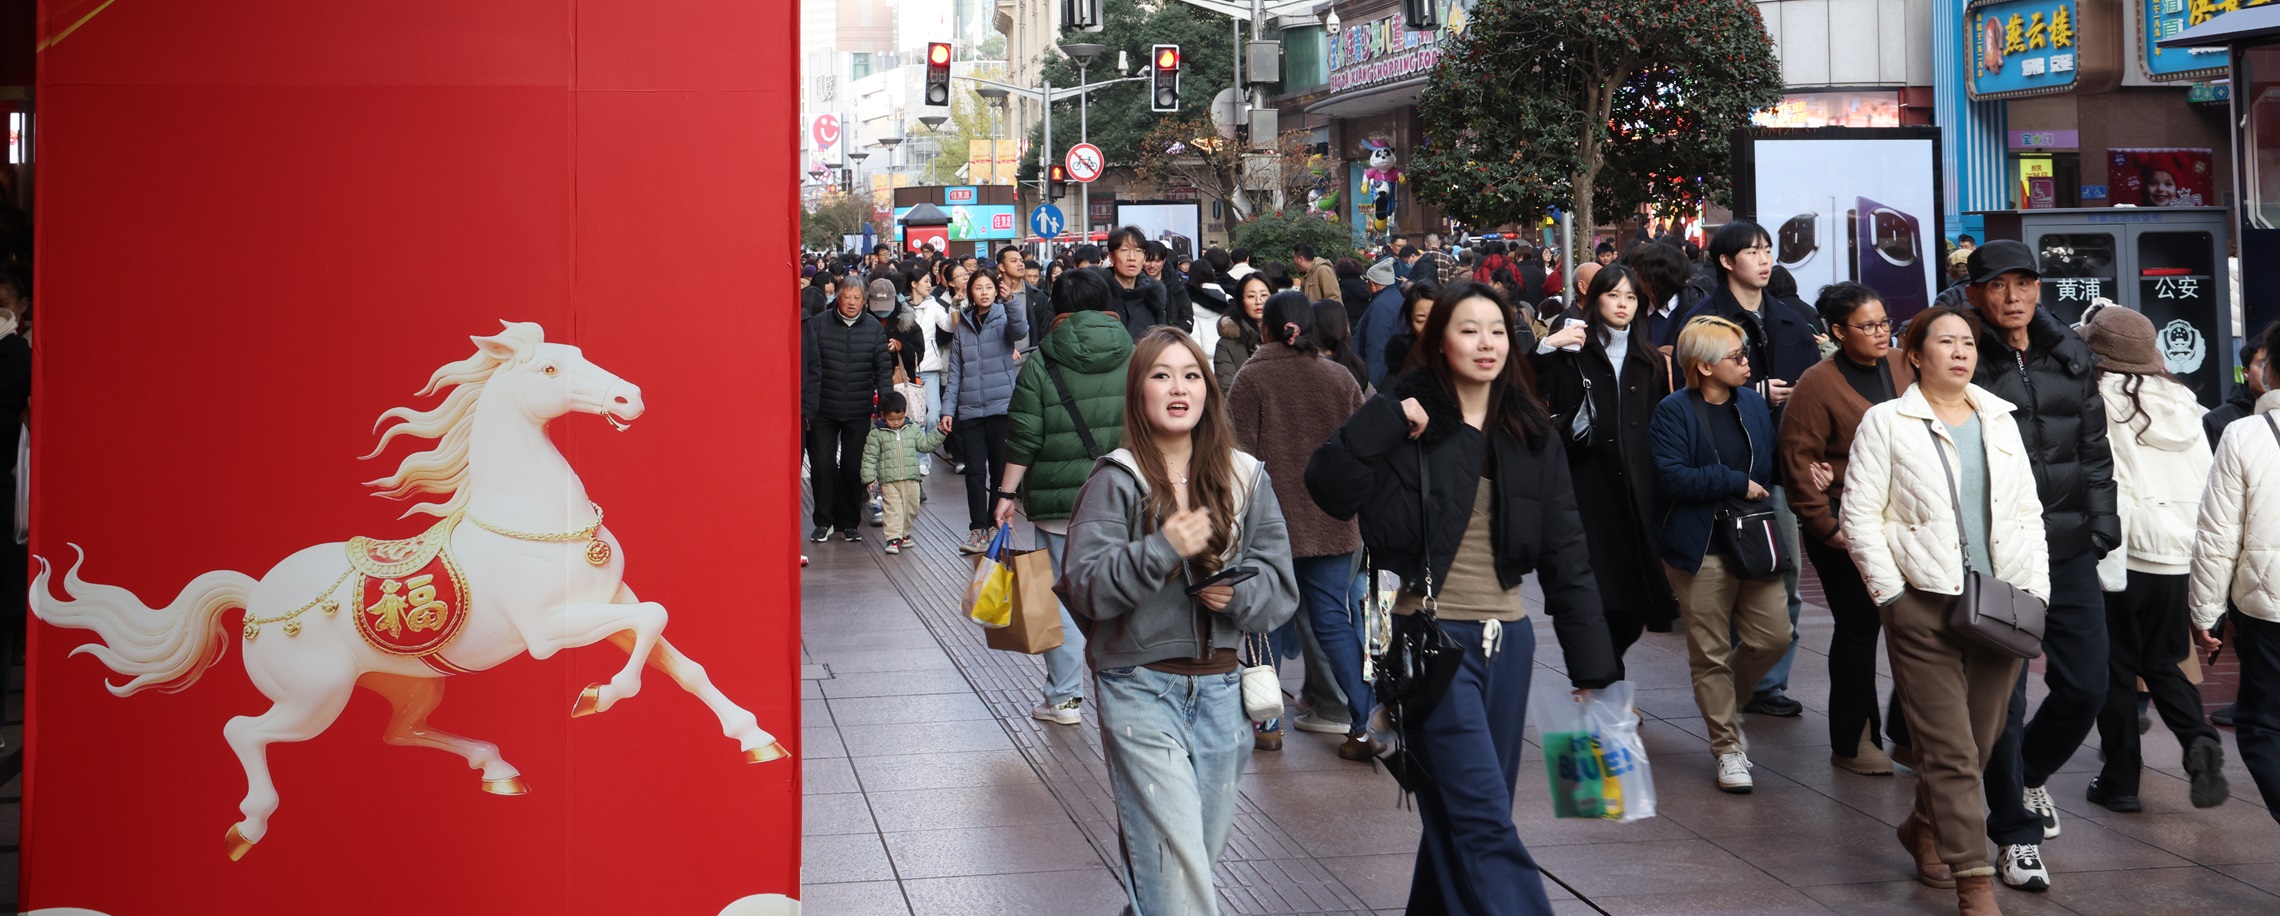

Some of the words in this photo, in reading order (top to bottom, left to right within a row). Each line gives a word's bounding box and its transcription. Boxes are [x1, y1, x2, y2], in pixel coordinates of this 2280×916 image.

[2003, 5, 2076, 56] 燕云楼
[1373, 55, 1416, 83] SHOPPING
[2021, 132, 2055, 147] 宝大祥
[2056, 278, 2100, 301] 黄浦
[2154, 276, 2199, 299] 公安
[367, 574, 449, 640] 福
